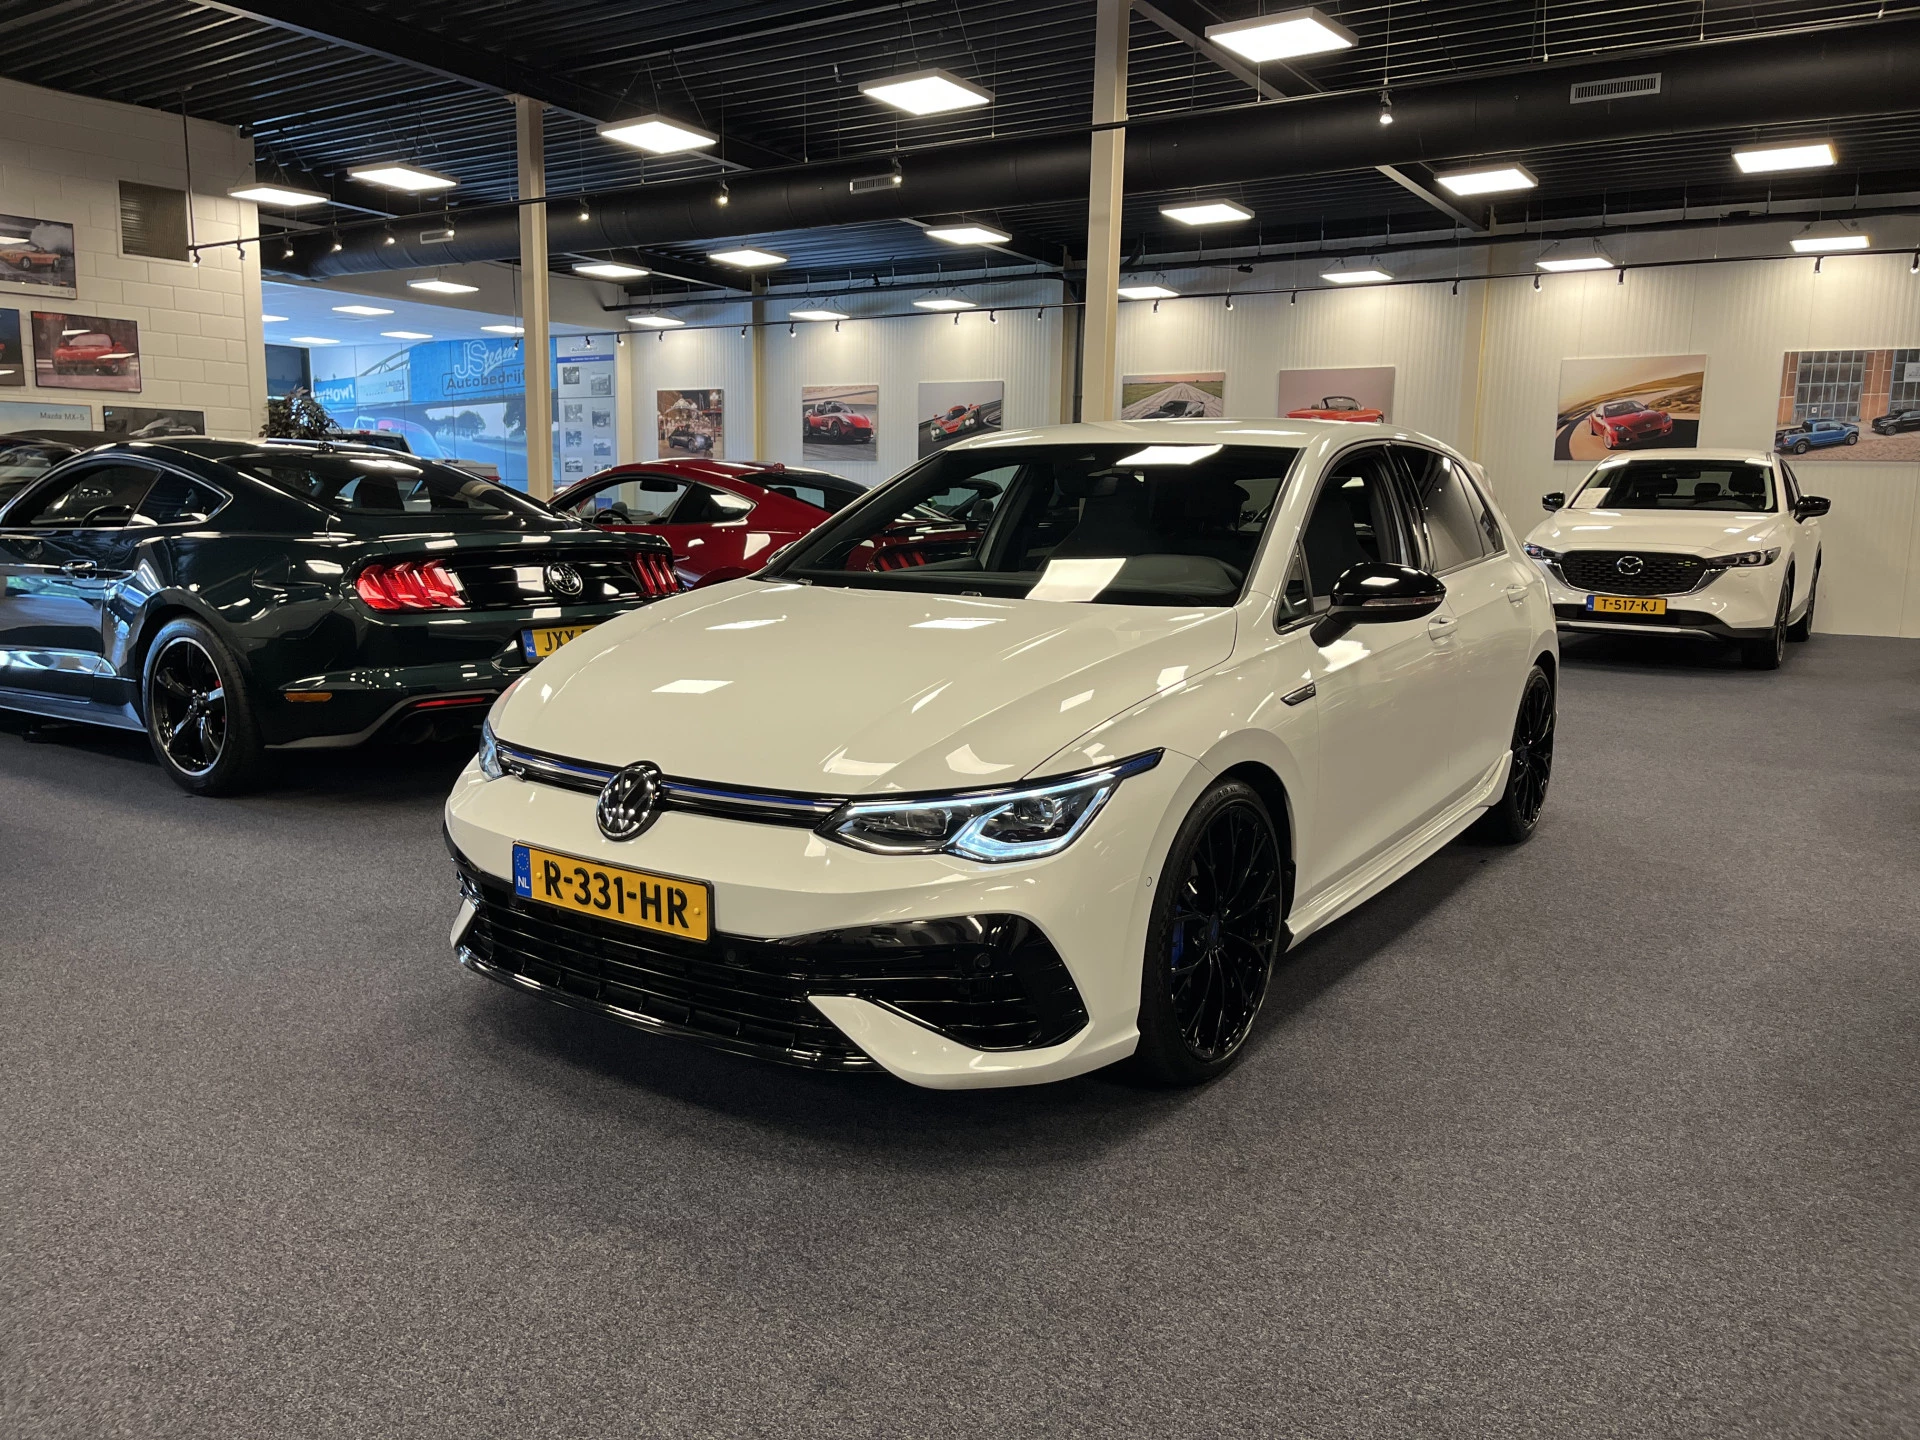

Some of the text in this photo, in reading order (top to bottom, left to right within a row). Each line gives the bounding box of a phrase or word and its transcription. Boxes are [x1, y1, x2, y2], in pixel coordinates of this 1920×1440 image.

[40, 412, 85, 421] Mazda MX-5
[1601, 598, 1657, 612] T-517-KJ
[517, 876, 530, 889] NL
[543, 859, 689, 929] R-331-HR
